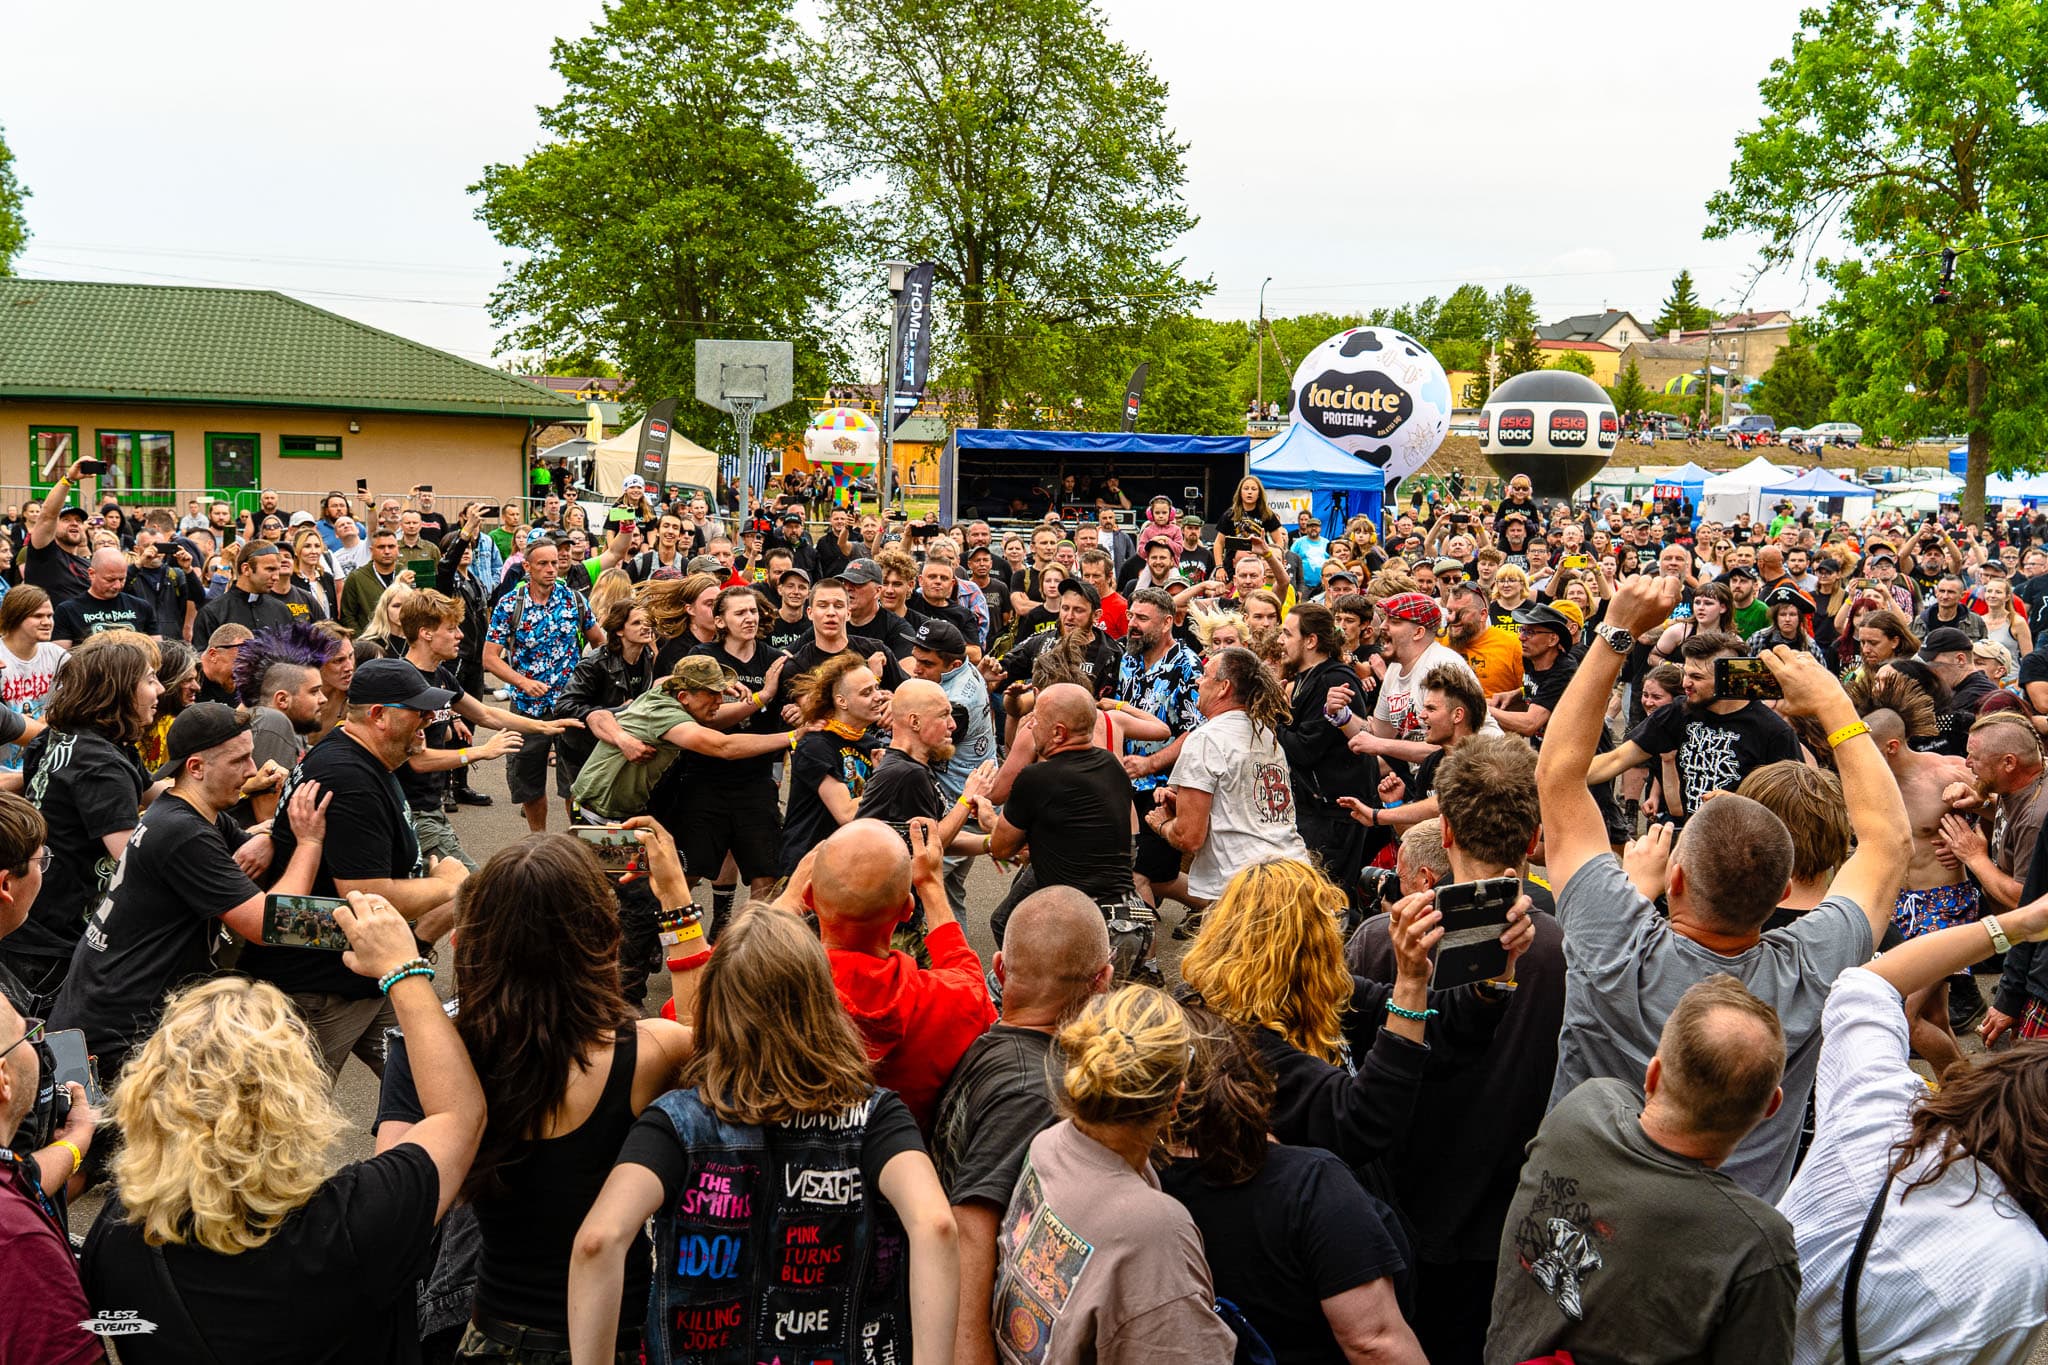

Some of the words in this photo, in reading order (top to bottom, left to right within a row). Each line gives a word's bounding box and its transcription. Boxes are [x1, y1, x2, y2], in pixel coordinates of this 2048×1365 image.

[1308, 383, 1400, 413] łaciate
[1323, 411, 1377, 428] PROTEIN+
[1501, 417, 1531, 428] eska
[1552, 417, 1586, 428] eska
[1500, 429, 1531, 439] ROCK
[1551, 430, 1586, 440] ROCK
[1290, 498, 1310, 511] TV
[84, 611, 105, 623] ROCK
[771, 633, 789, 646] ROCK
[699, 1172, 732, 1193] THE
[785, 1162, 863, 1205] VISAGE
[681, 1188, 752, 1219] SMITHS
[1552, 1200, 1592, 1223] DEAD
[786, 1225, 821, 1245] PINK
[1042, 1209, 1088, 1256] OFFSPRING
[677, 1234, 742, 1280] IDOL
[784, 1245, 843, 1264] TURNS
[781, 1266, 826, 1284] BLUE
[676, 1302, 742, 1331] KILLING
[775, 1309, 830, 1341] CURE
[683, 1330, 730, 1350] JOKE
